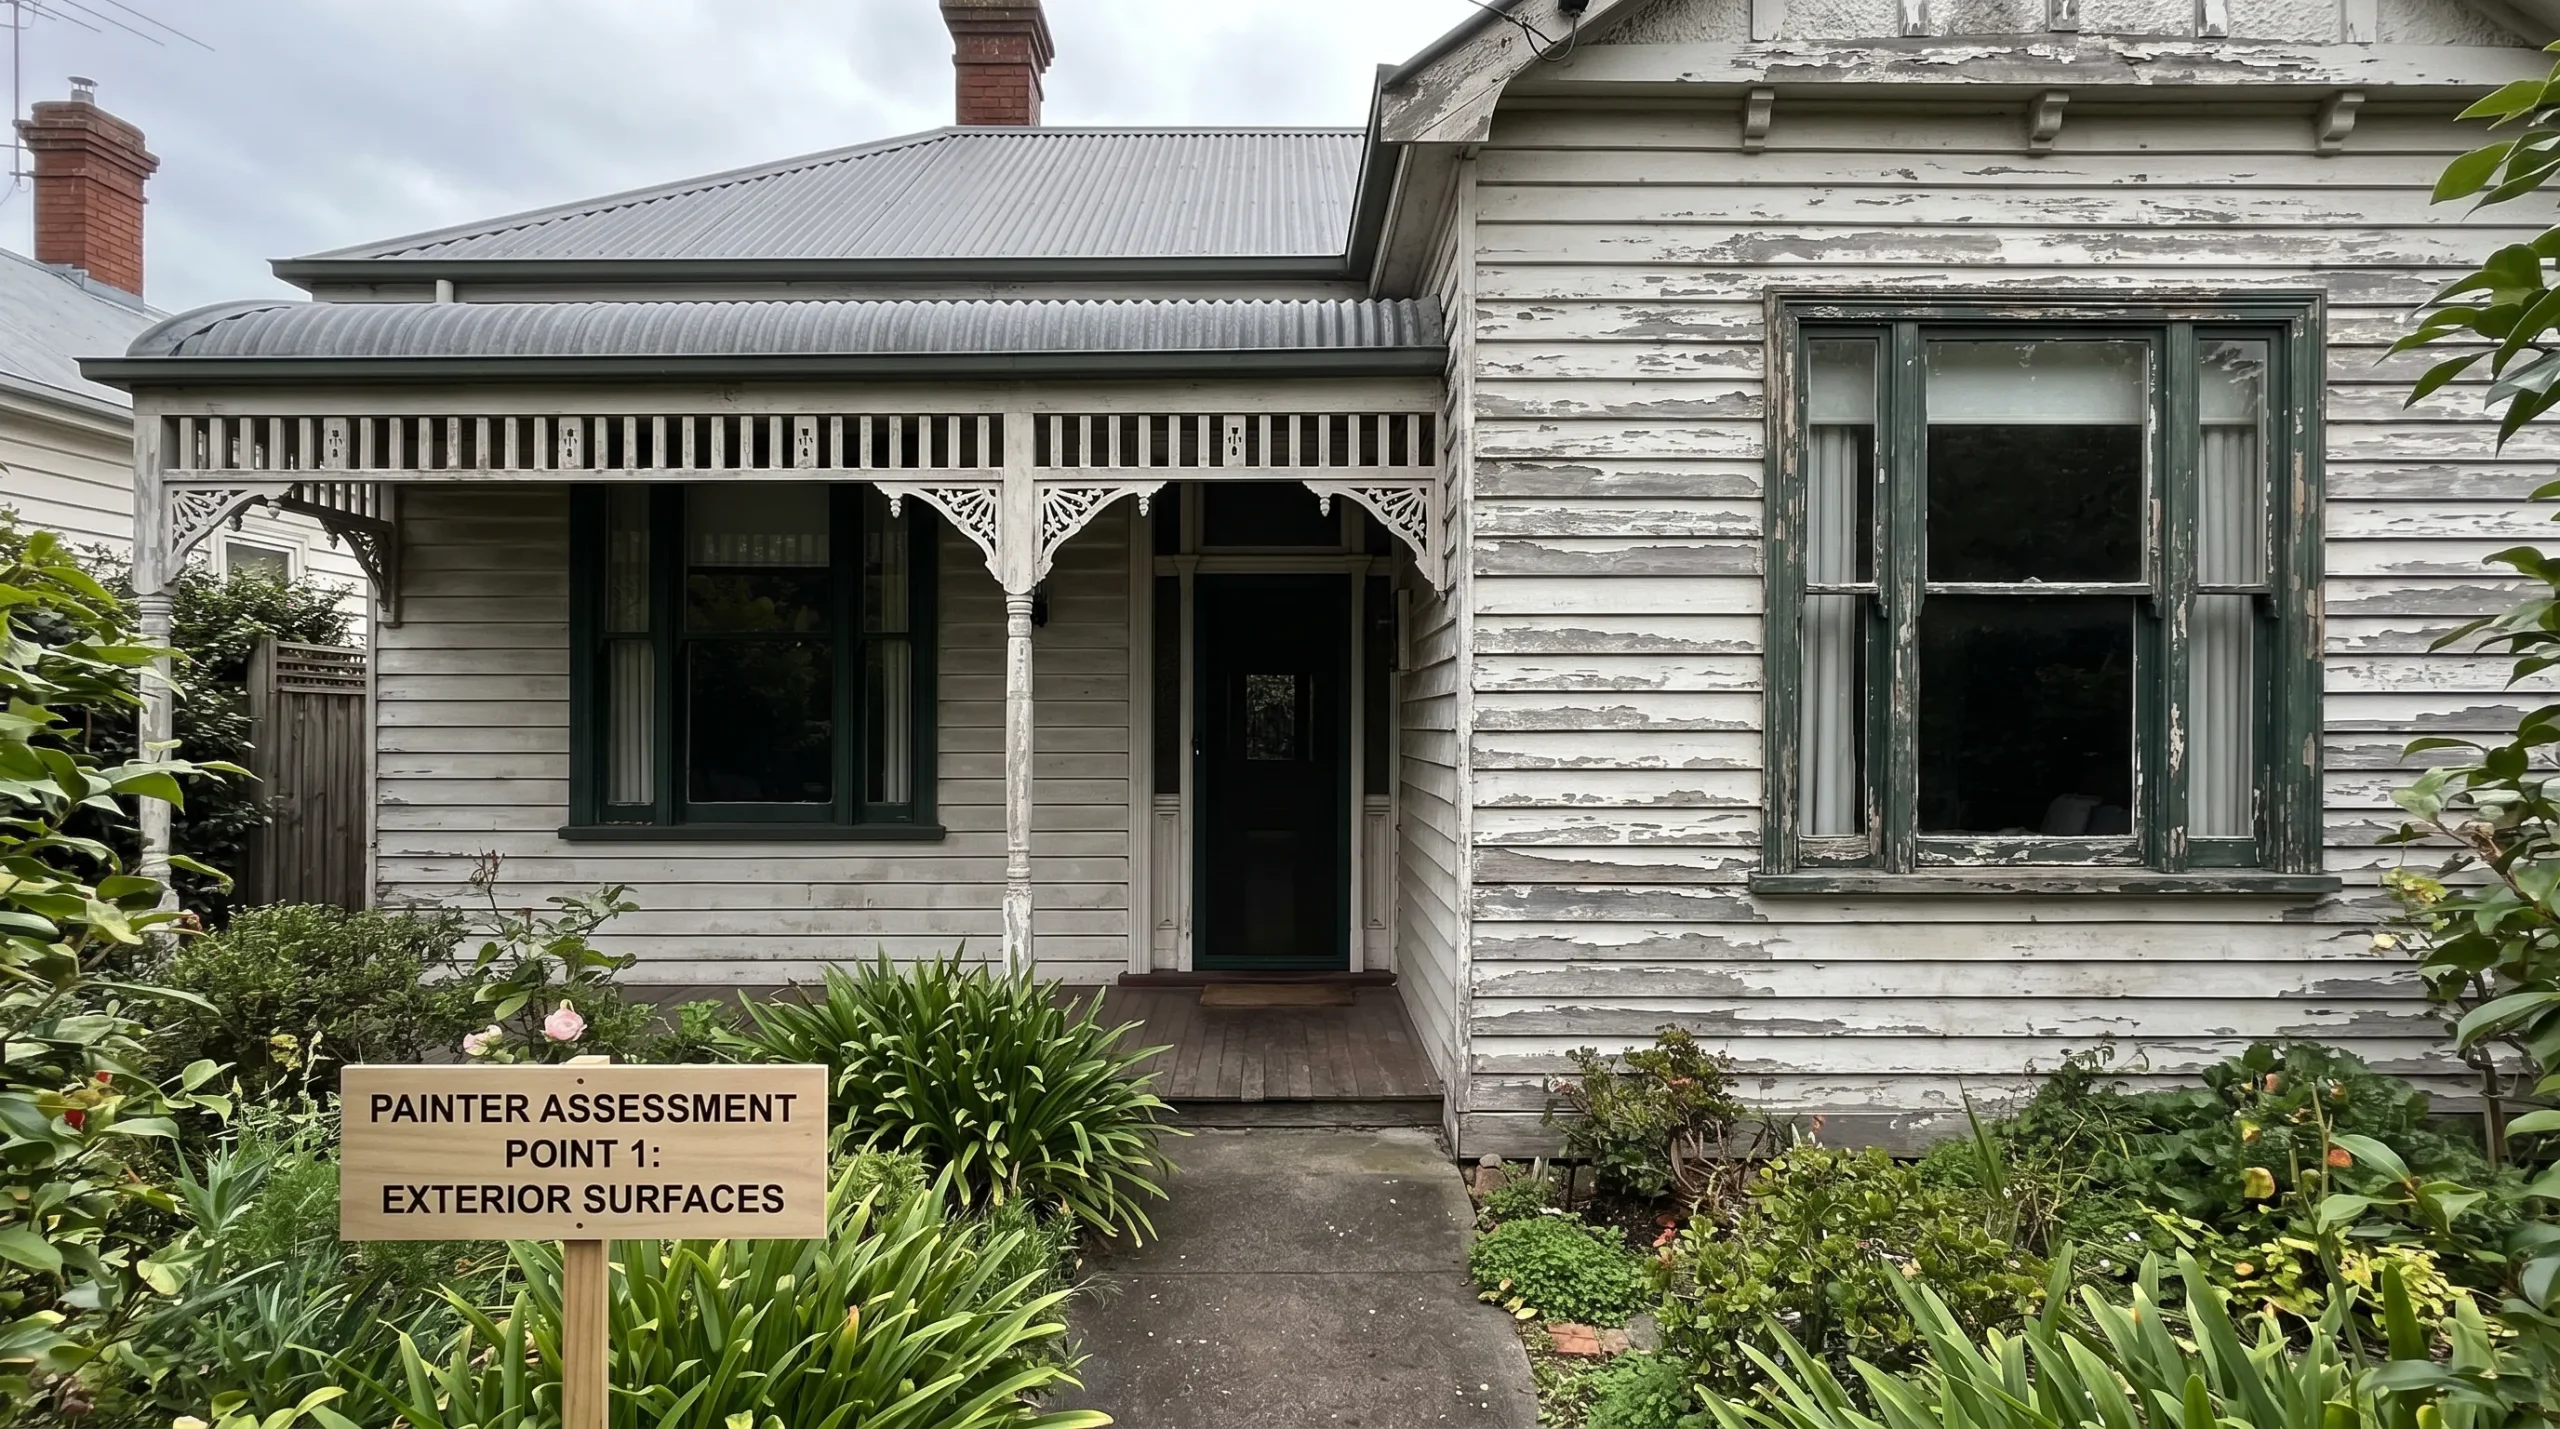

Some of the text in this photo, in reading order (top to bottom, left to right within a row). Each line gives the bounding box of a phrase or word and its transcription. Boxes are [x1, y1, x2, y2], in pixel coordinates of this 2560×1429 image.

[371, 1093, 797, 1123] PAINTER ASSESSMENT
[506, 1139, 660, 1168] POINT 1:
[382, 1184, 784, 1214] EXTERIOR SURFACES
